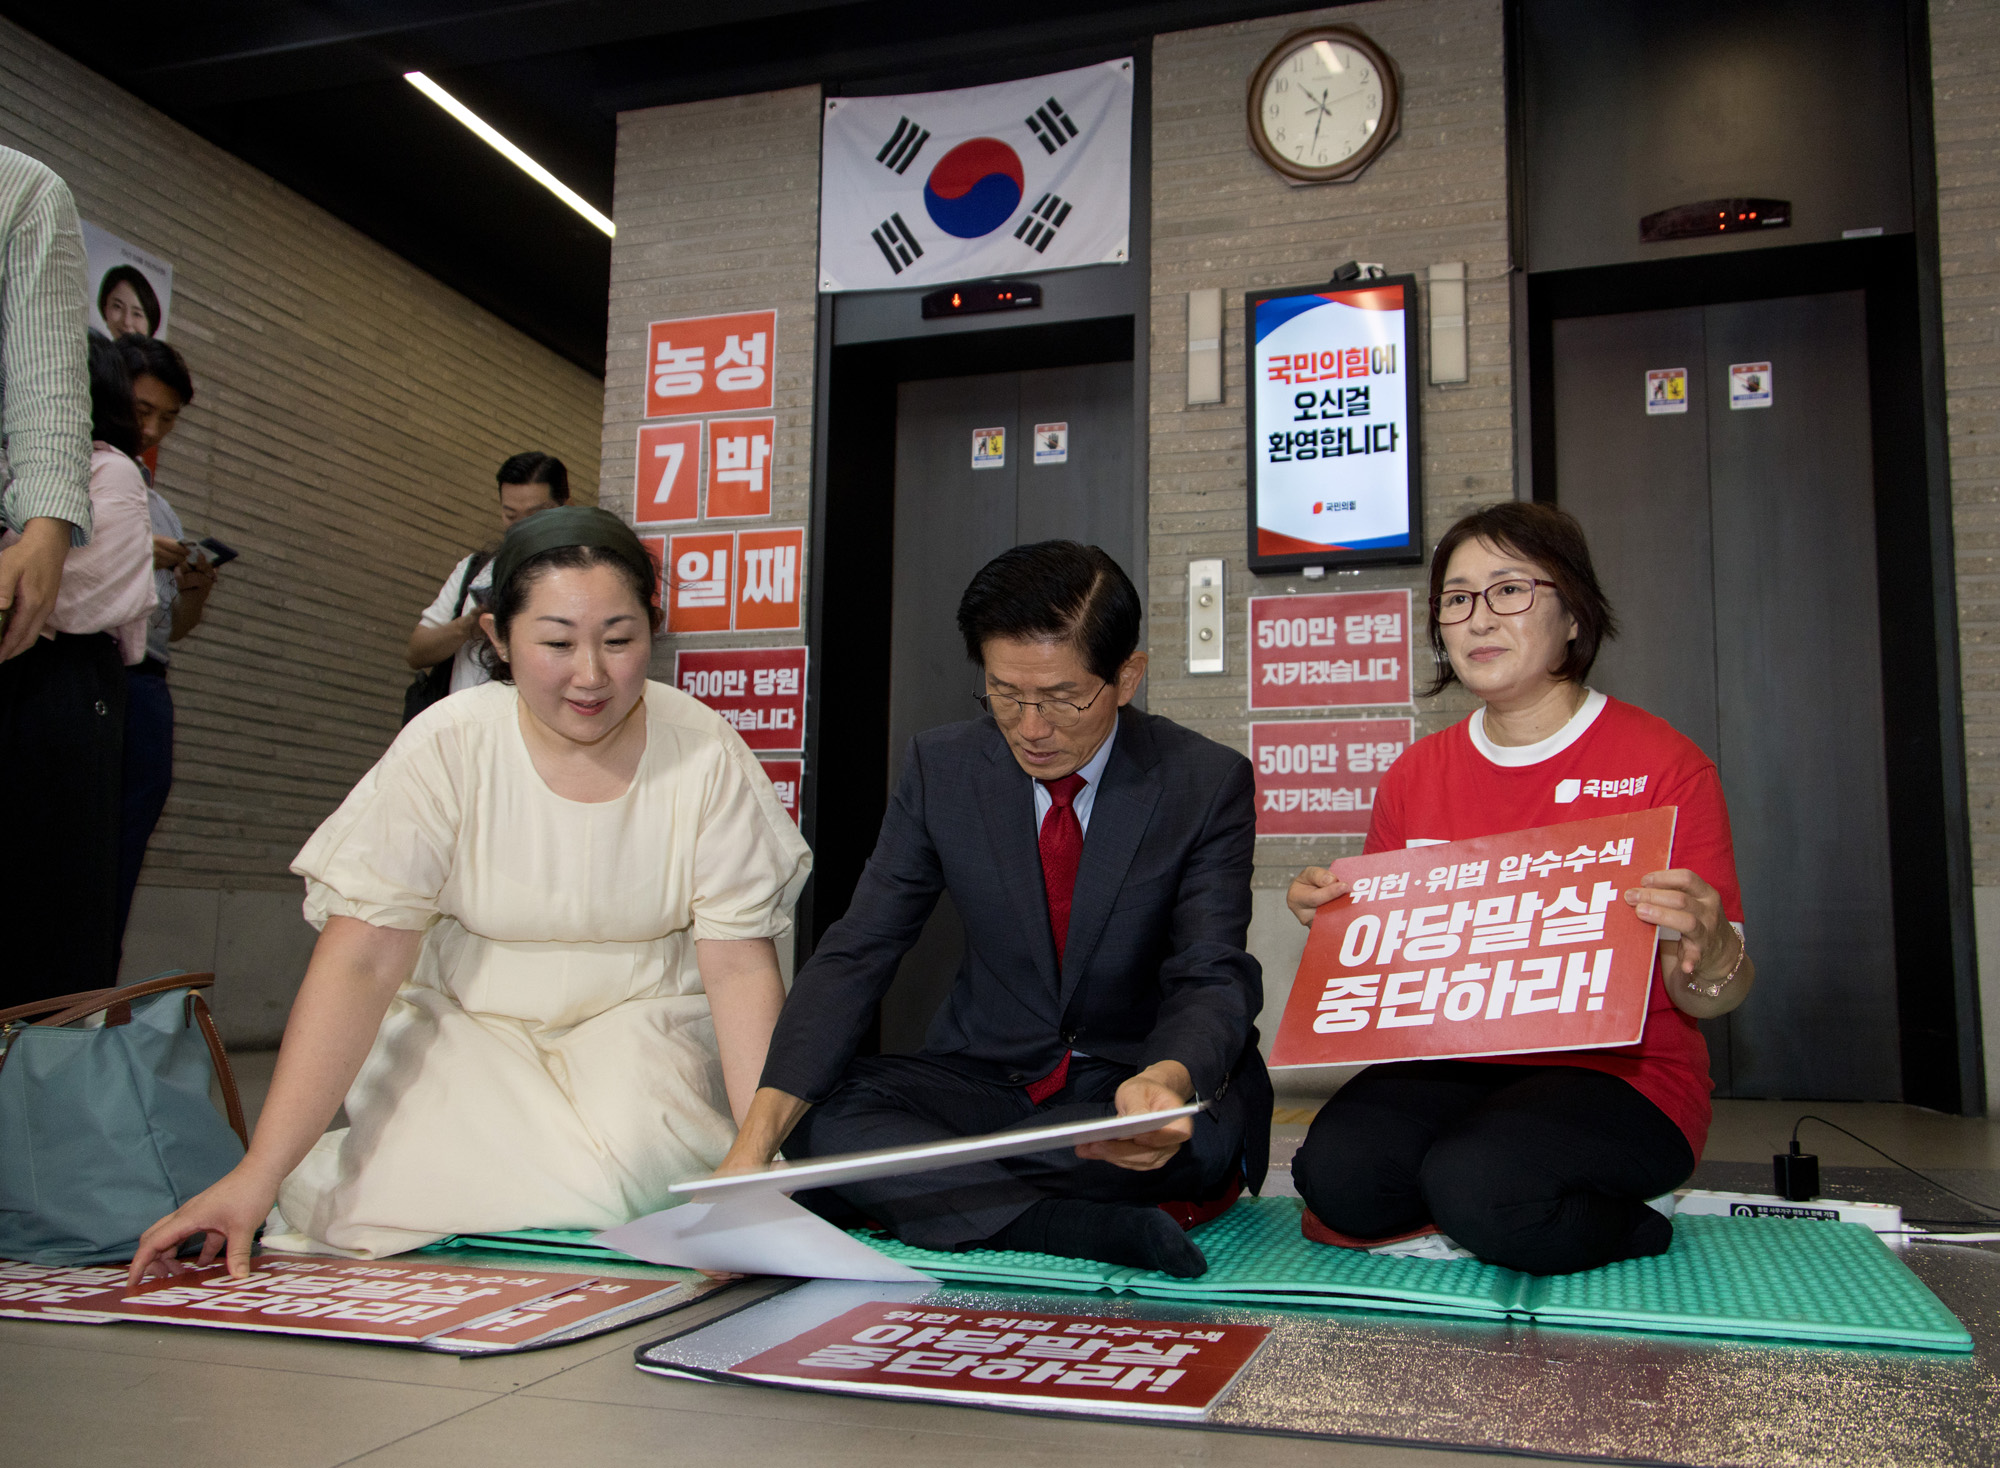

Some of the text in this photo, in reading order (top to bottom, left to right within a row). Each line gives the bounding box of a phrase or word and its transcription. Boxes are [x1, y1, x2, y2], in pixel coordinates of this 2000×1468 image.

[1293, 55, 1305, 73] 11
[1360, 69, 1370, 85] 2
[1275, 77, 1289, 94] 10
[1270, 104, 1280, 120] 9
[1367, 94, 1376, 111] 3
[1276, 127, 1286, 142] 8
[1342, 140, 1352, 156] 5
[1295, 145, 1305, 161] 7
[1317, 149, 1328, 165] 6
[654, 332, 766, 398] 농성
[1267, 344, 1397, 385] 국민의힘에
[1293, 385, 1371, 422] 오신걸
[1268, 422, 1399, 463] 환영합니다
[1326, 500, 1357, 513] 국민의힘
[676, 545, 796, 608] 일째
[1257, 613, 1402, 648] 500만 당원
[682, 667, 799, 698] 500만 당원
[1262, 657, 1401, 686] 지키겠습니다
[715, 707, 797, 731] 겠습니다
[1259, 741, 1404, 775] 500만 당원
[1583, 774, 1649, 799] 국민의힘
[1497, 837, 1635, 884] 압수수색
[1337, 880, 1619, 968] 야당말살
[1312, 947, 1615, 1035] 중단하라!
[201, 1271, 502, 1305] 야당말살
[405, 1271, 548, 1288] 압수수색
[120, 1286, 460, 1326] 중단하라!
[851, 1324, 1201, 1367] 야당말살
[1063, 1322, 1226, 1343] 압수수색
[797, 1344, 1187, 1393] 중단하라!
